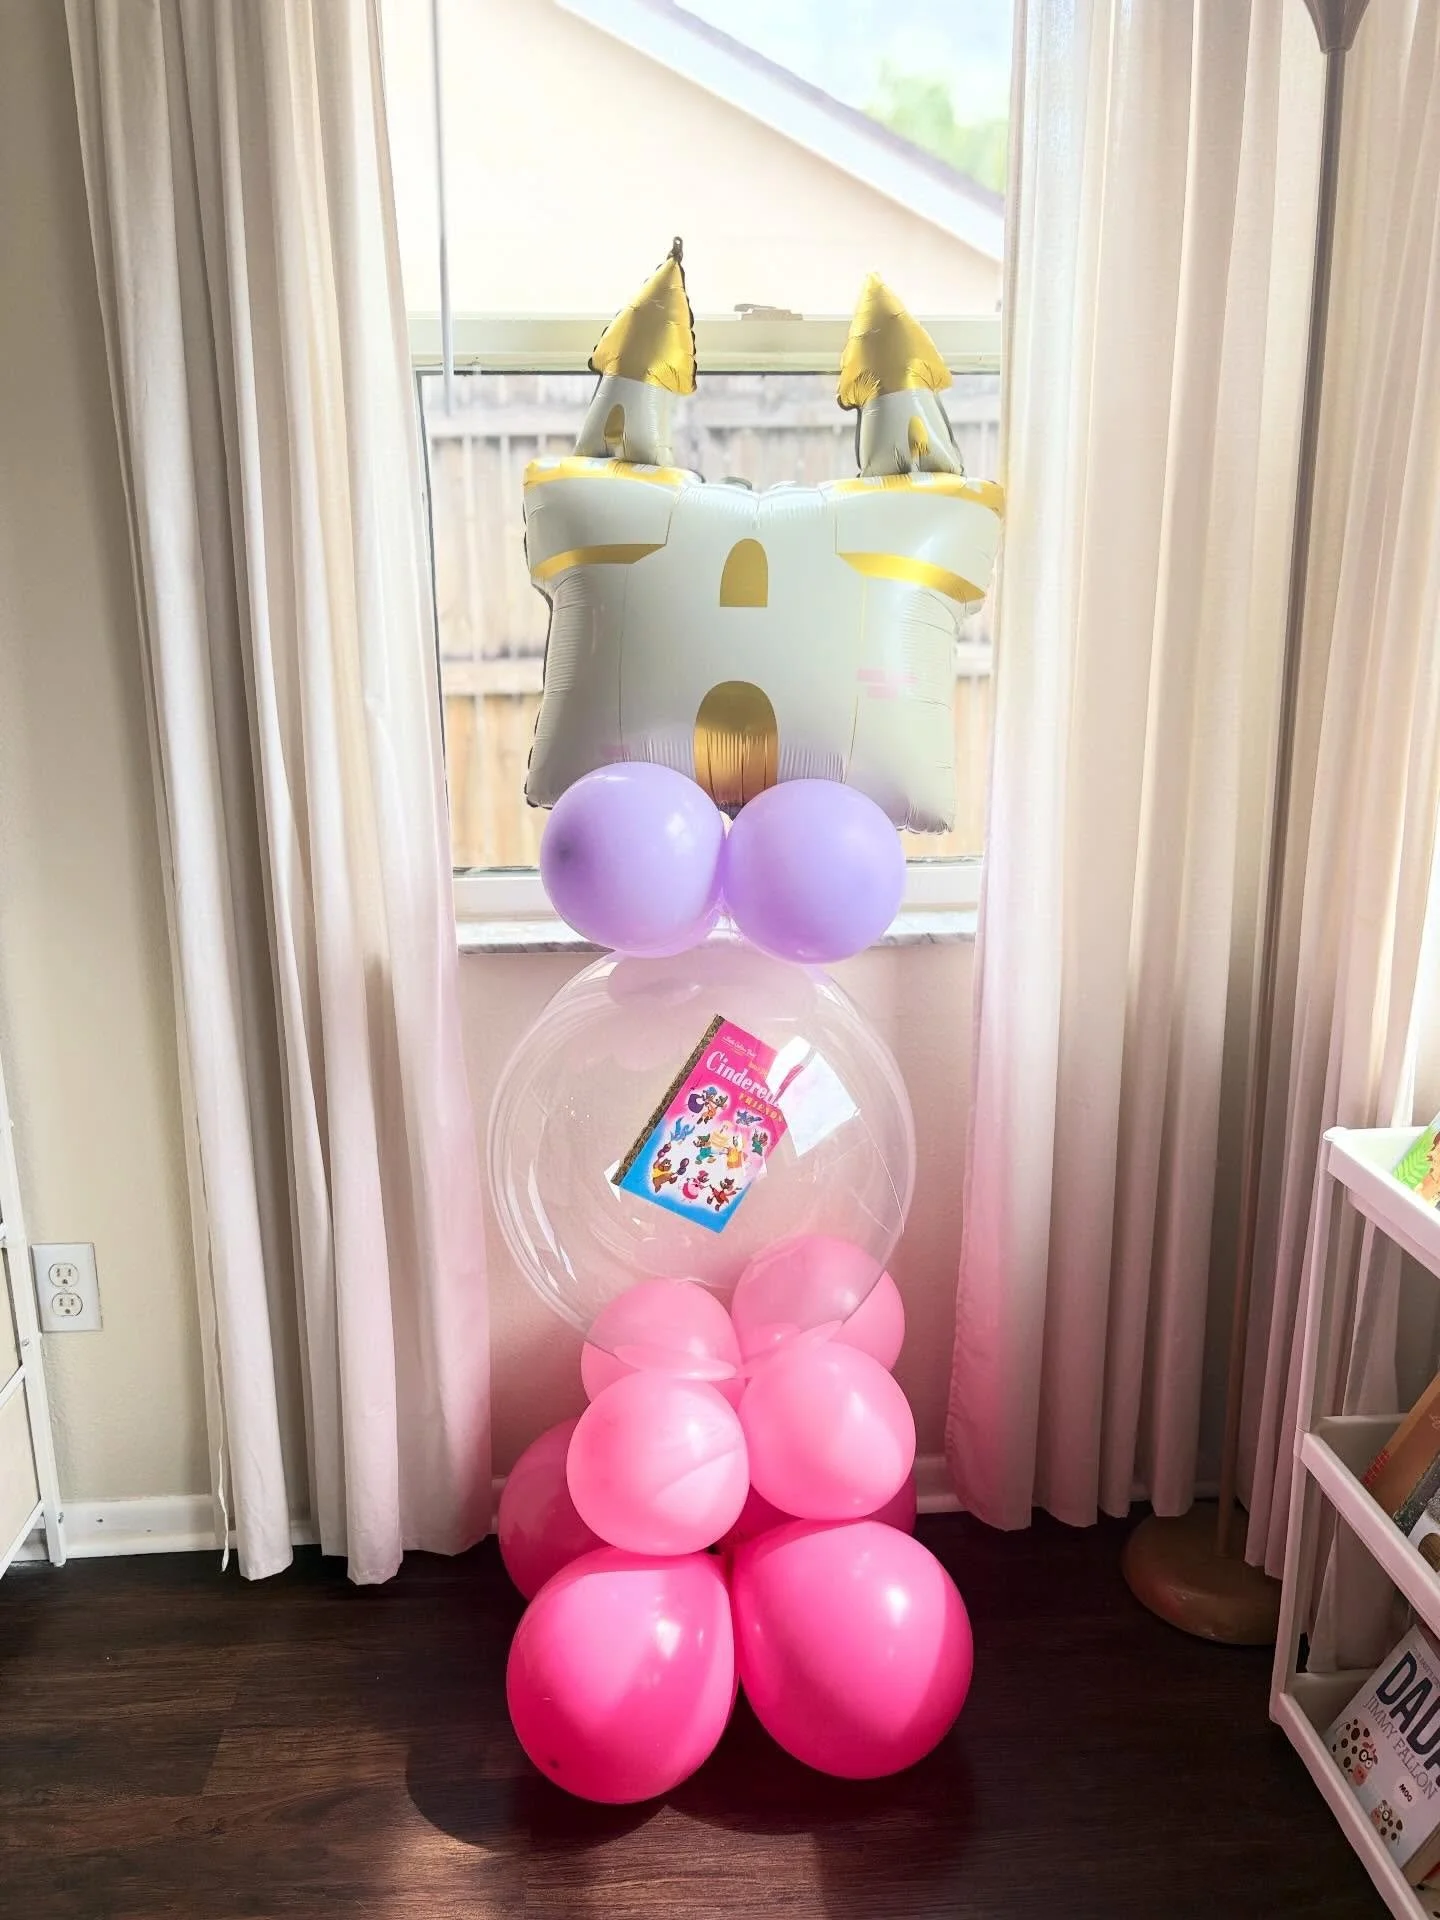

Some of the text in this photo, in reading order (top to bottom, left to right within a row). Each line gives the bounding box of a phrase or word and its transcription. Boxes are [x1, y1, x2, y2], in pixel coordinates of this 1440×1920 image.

[1363, 1695, 1439, 1800] JIMMY FALLON
[1399, 1784, 1413, 1802] MOO
